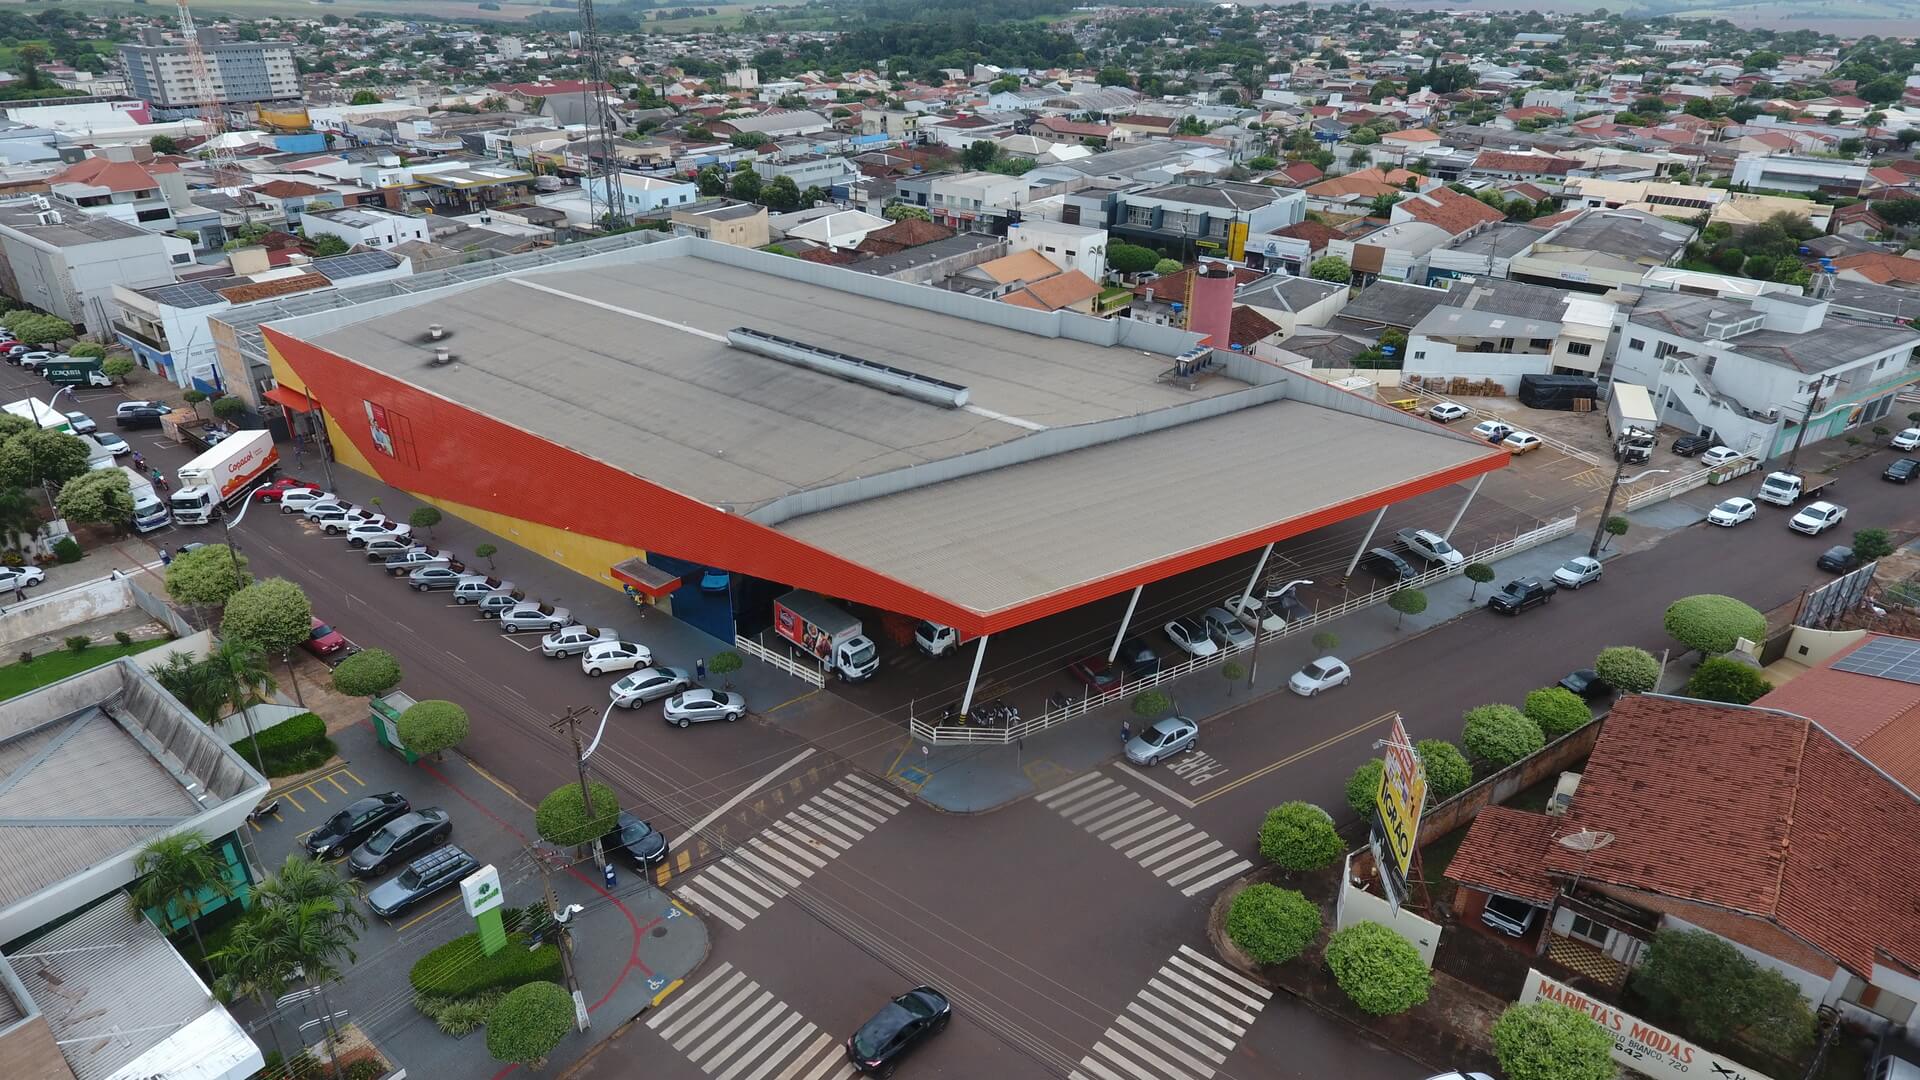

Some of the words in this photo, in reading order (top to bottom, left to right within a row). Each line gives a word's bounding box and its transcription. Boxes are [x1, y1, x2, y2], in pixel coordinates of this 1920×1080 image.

[228, 450, 254, 473] Copacol
[1166, 750, 1229, 786] PARE
[1381, 769, 1408, 858] TIGRÃO
[1629, 1022, 1696, 1064] MODAS
[1668, 1058, 1689, 1073] 720
